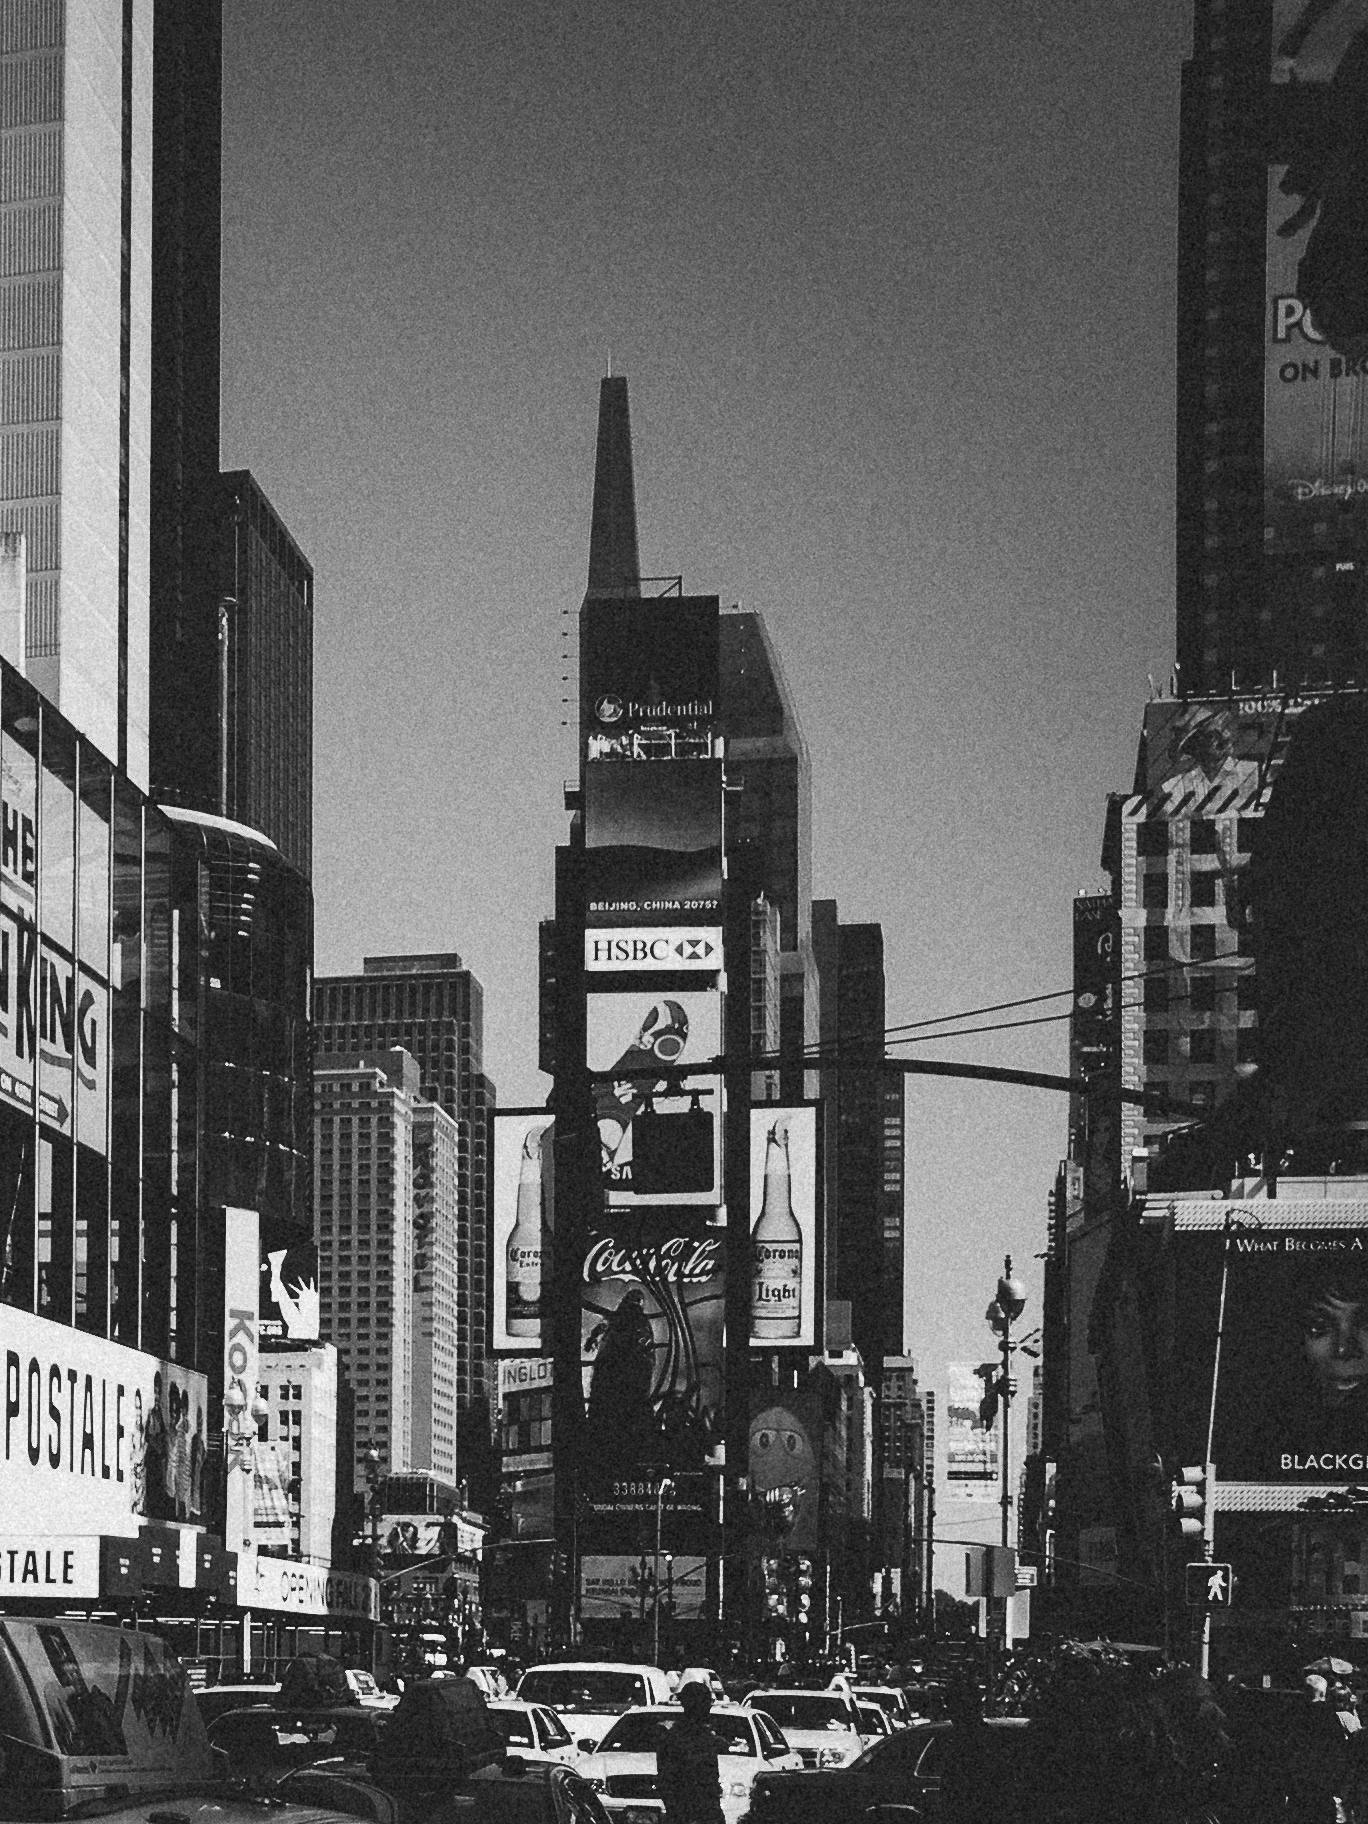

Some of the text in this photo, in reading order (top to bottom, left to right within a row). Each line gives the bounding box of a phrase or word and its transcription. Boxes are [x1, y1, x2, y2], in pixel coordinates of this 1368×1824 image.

[1279, 360, 1319, 383] ON
[628, 700, 714, 718] Prudential
[643, 901, 682, 911] CHINA
[592, 938, 669, 962] HSBC
[16, 905, 98, 1070] KING
